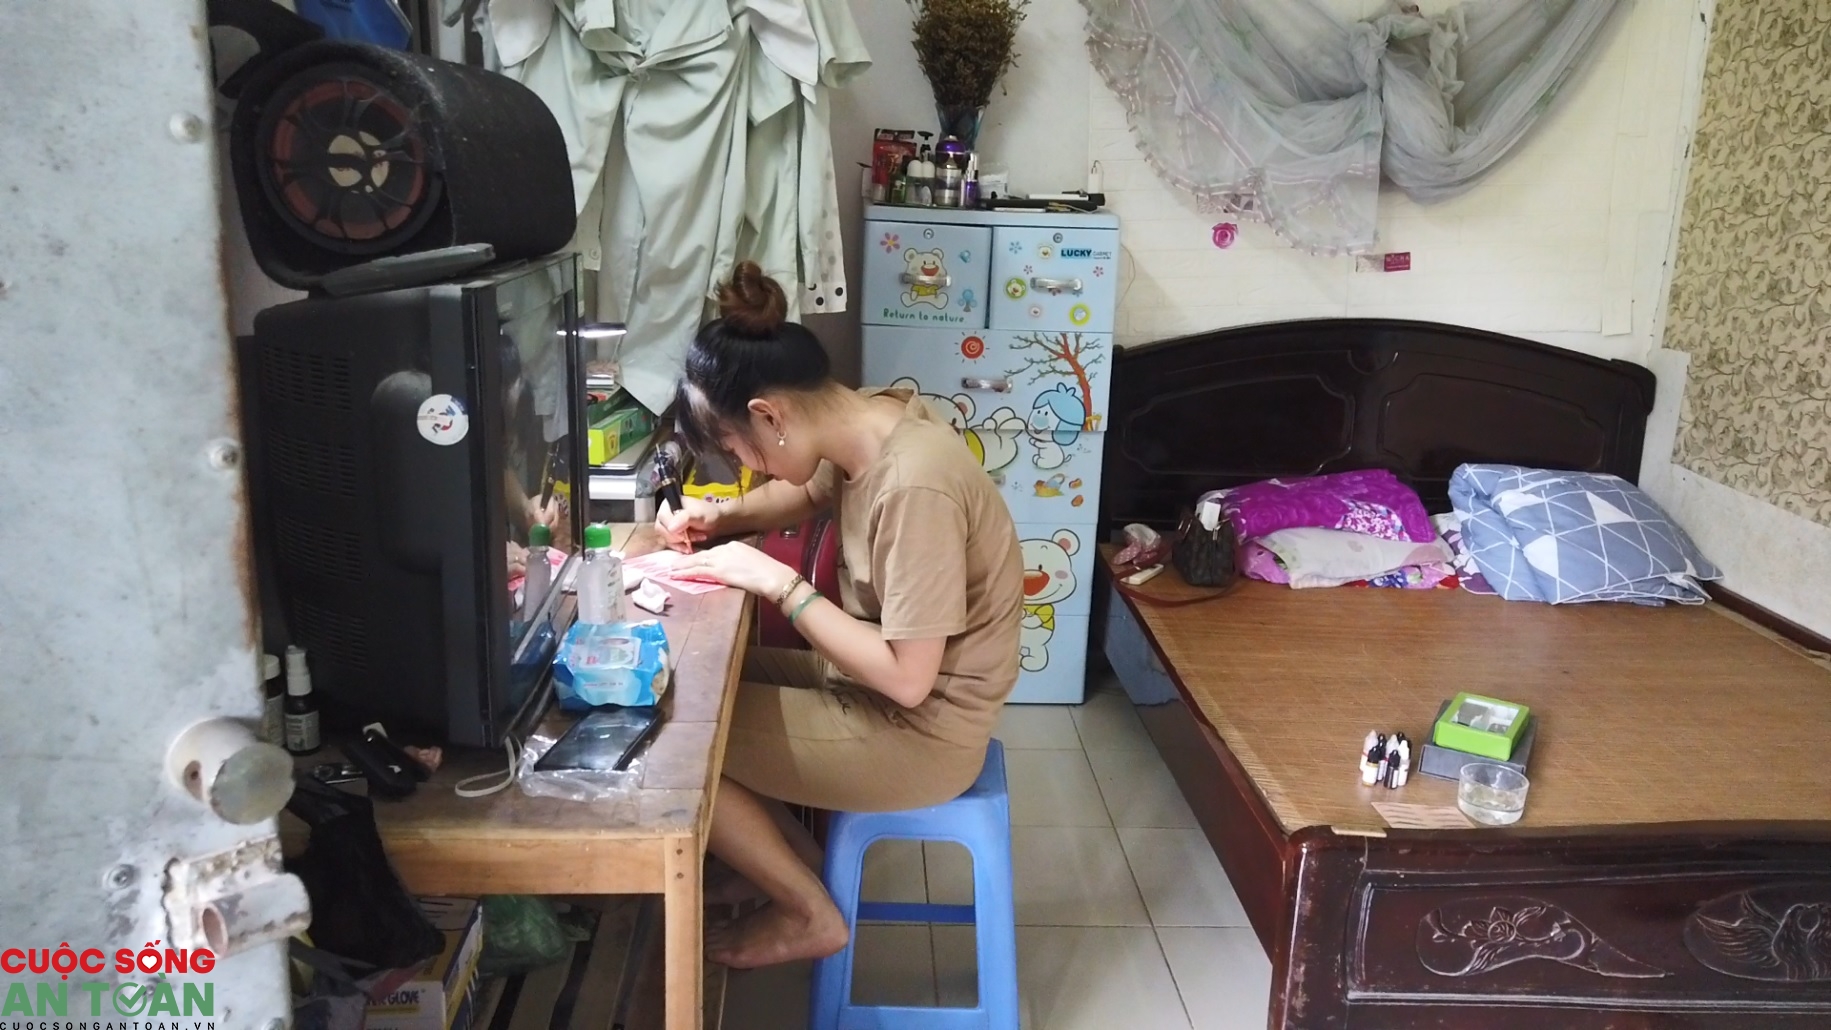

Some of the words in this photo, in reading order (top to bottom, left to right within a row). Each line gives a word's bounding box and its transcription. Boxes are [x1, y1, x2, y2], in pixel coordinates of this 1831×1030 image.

[1061, 249, 1092, 257] LUCKY
[883, 307, 916, 319] Return
[919, 311, 929, 321] to
[932, 313, 965, 323] nature
